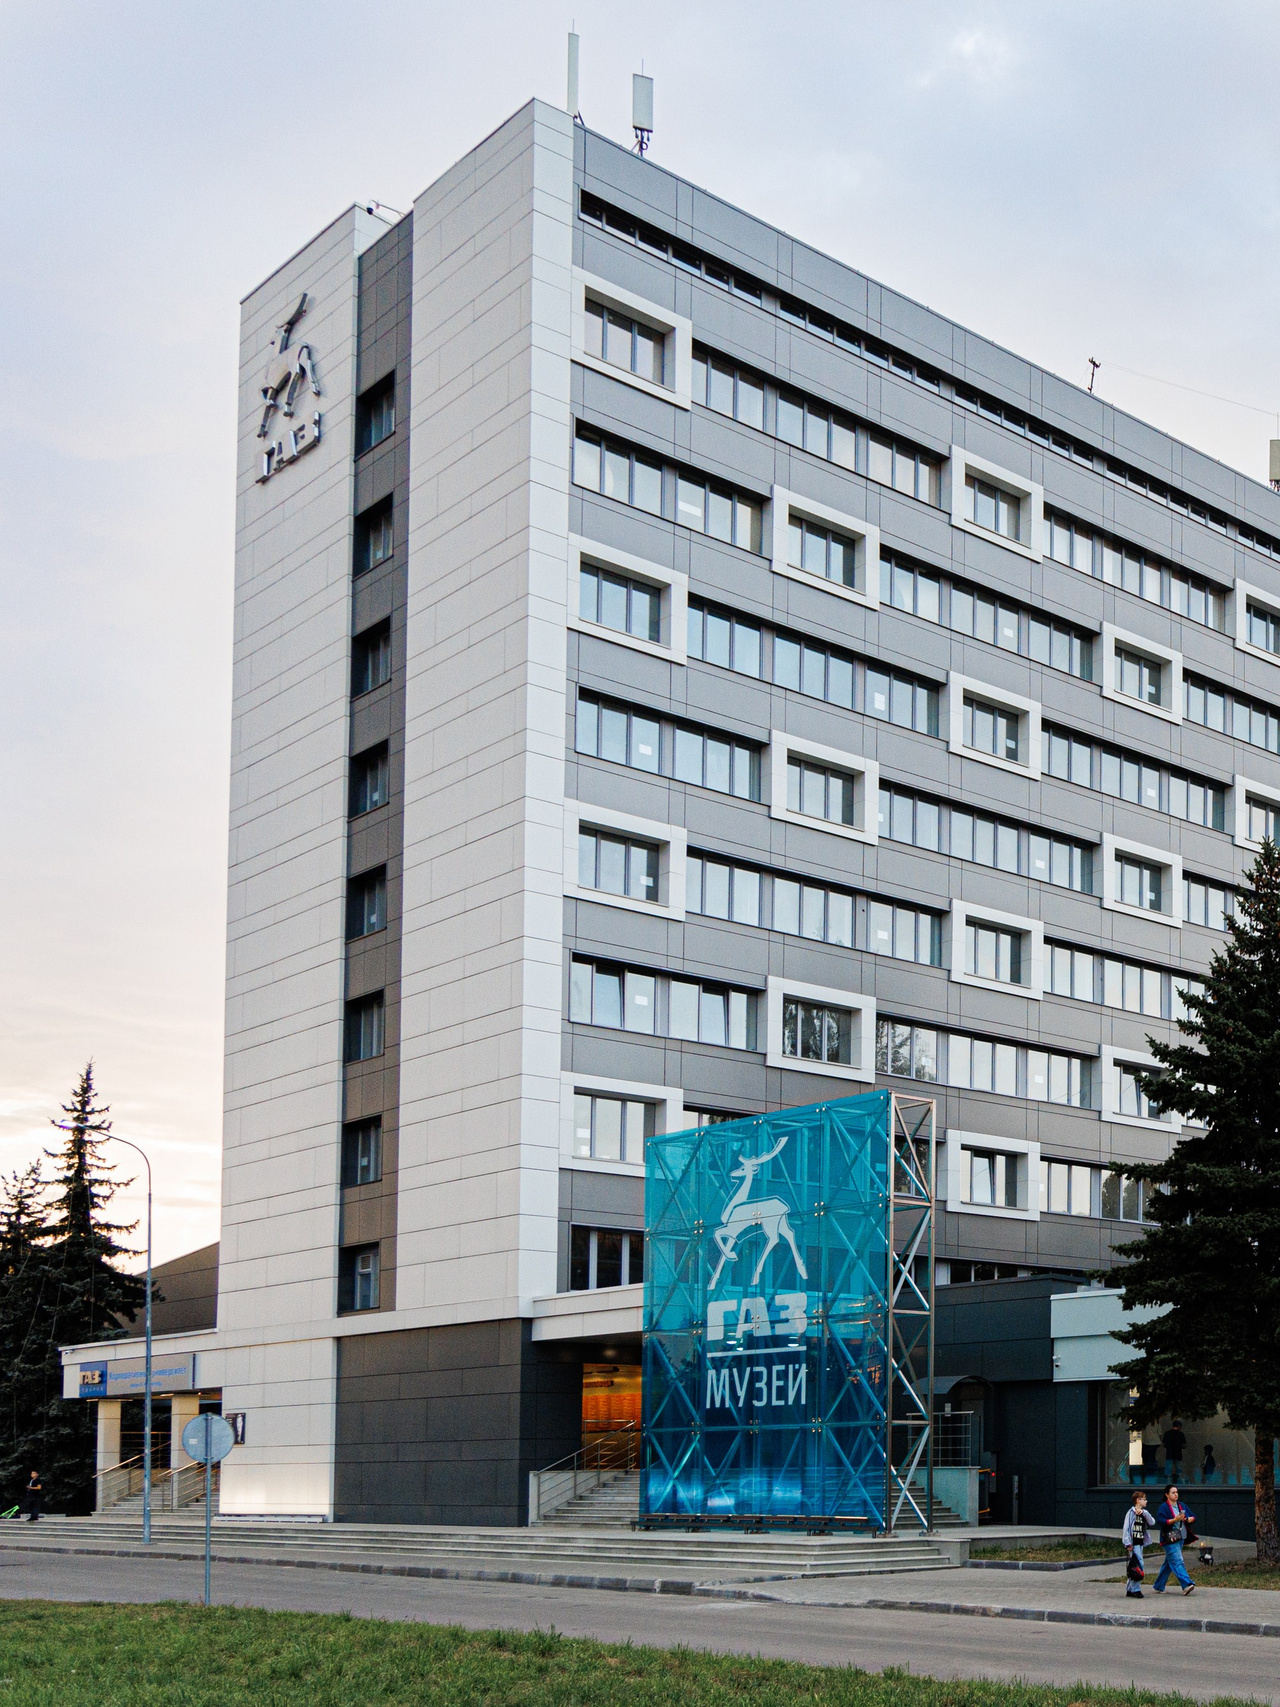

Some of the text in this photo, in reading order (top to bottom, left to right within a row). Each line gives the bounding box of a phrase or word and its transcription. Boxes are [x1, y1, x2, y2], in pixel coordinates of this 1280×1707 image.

[255, 410, 321, 484] ГАЗ
[707, 1292, 807, 1341] ГАЗ
[80, 1370, 100, 1385] ГАЗ
[706, 1363, 807, 1408] МУЗЕЙ
